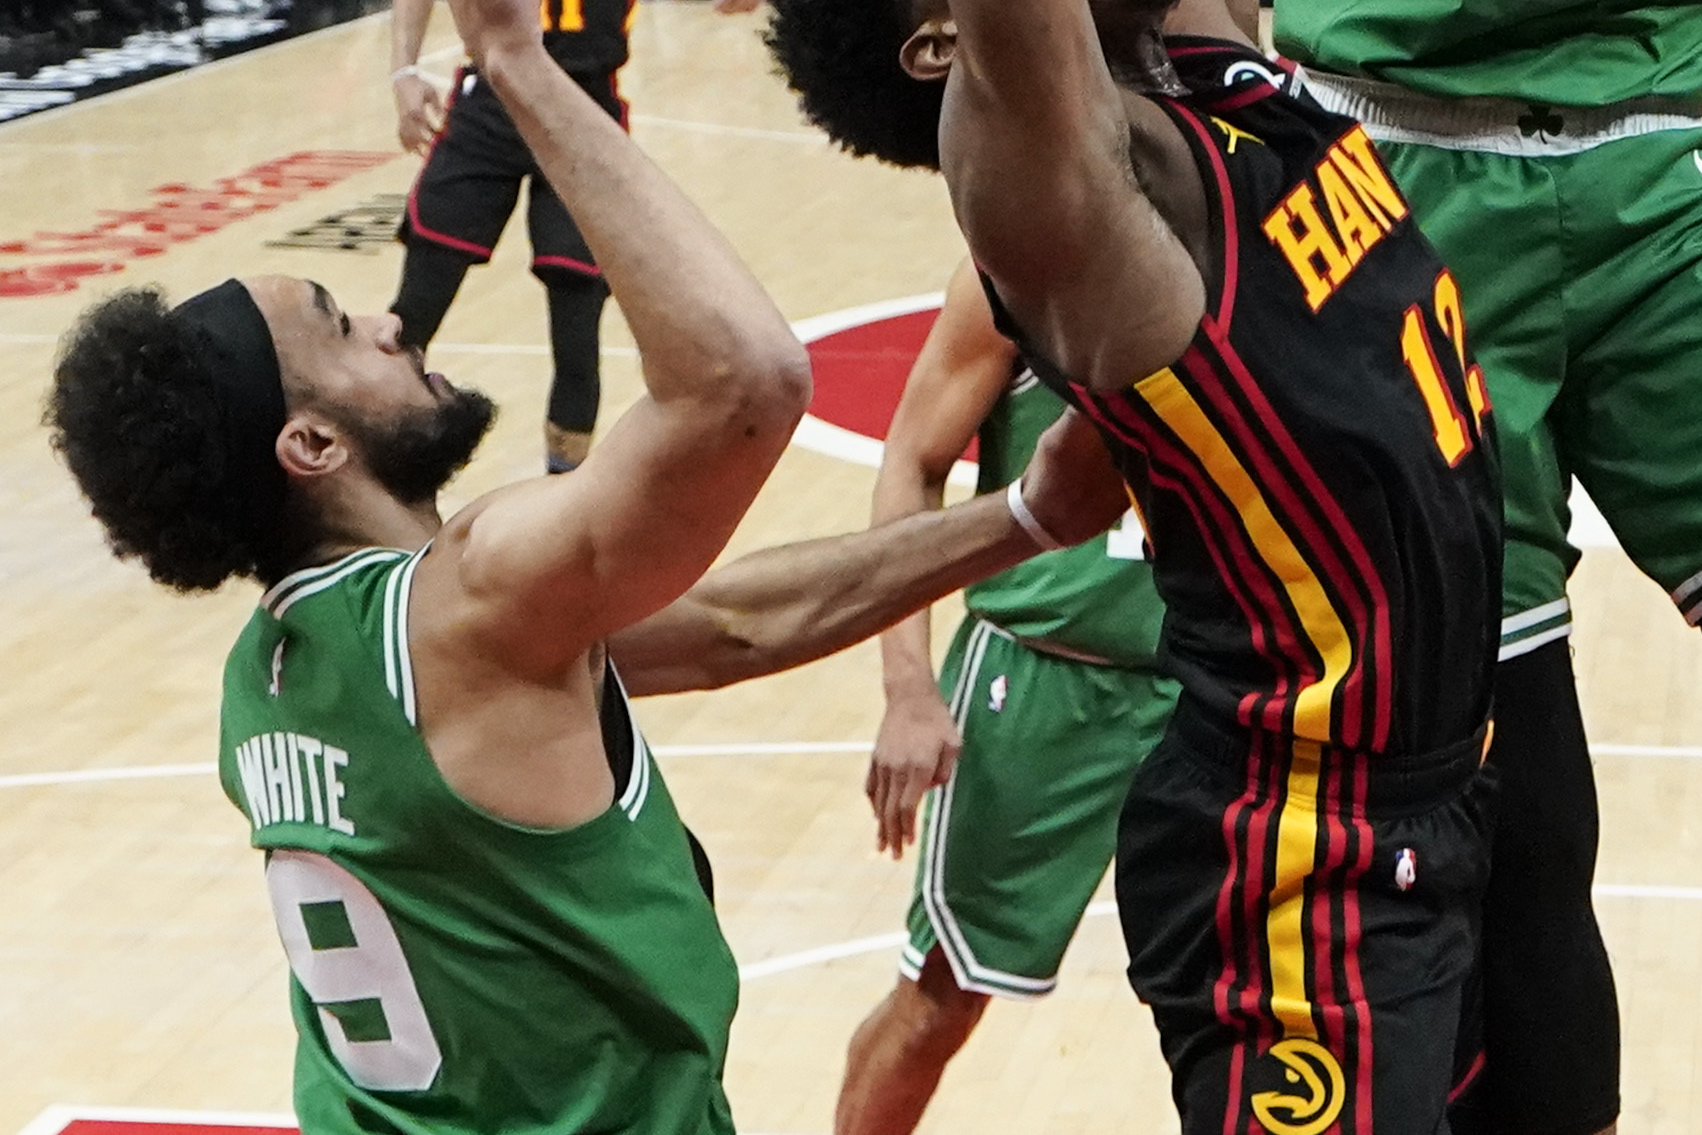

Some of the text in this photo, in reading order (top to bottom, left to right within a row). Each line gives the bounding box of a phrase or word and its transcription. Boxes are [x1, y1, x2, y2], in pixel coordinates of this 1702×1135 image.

[1400, 267, 1492, 468] 12
[235, 731, 356, 837] WHITE
[265, 849, 443, 1092] 9
